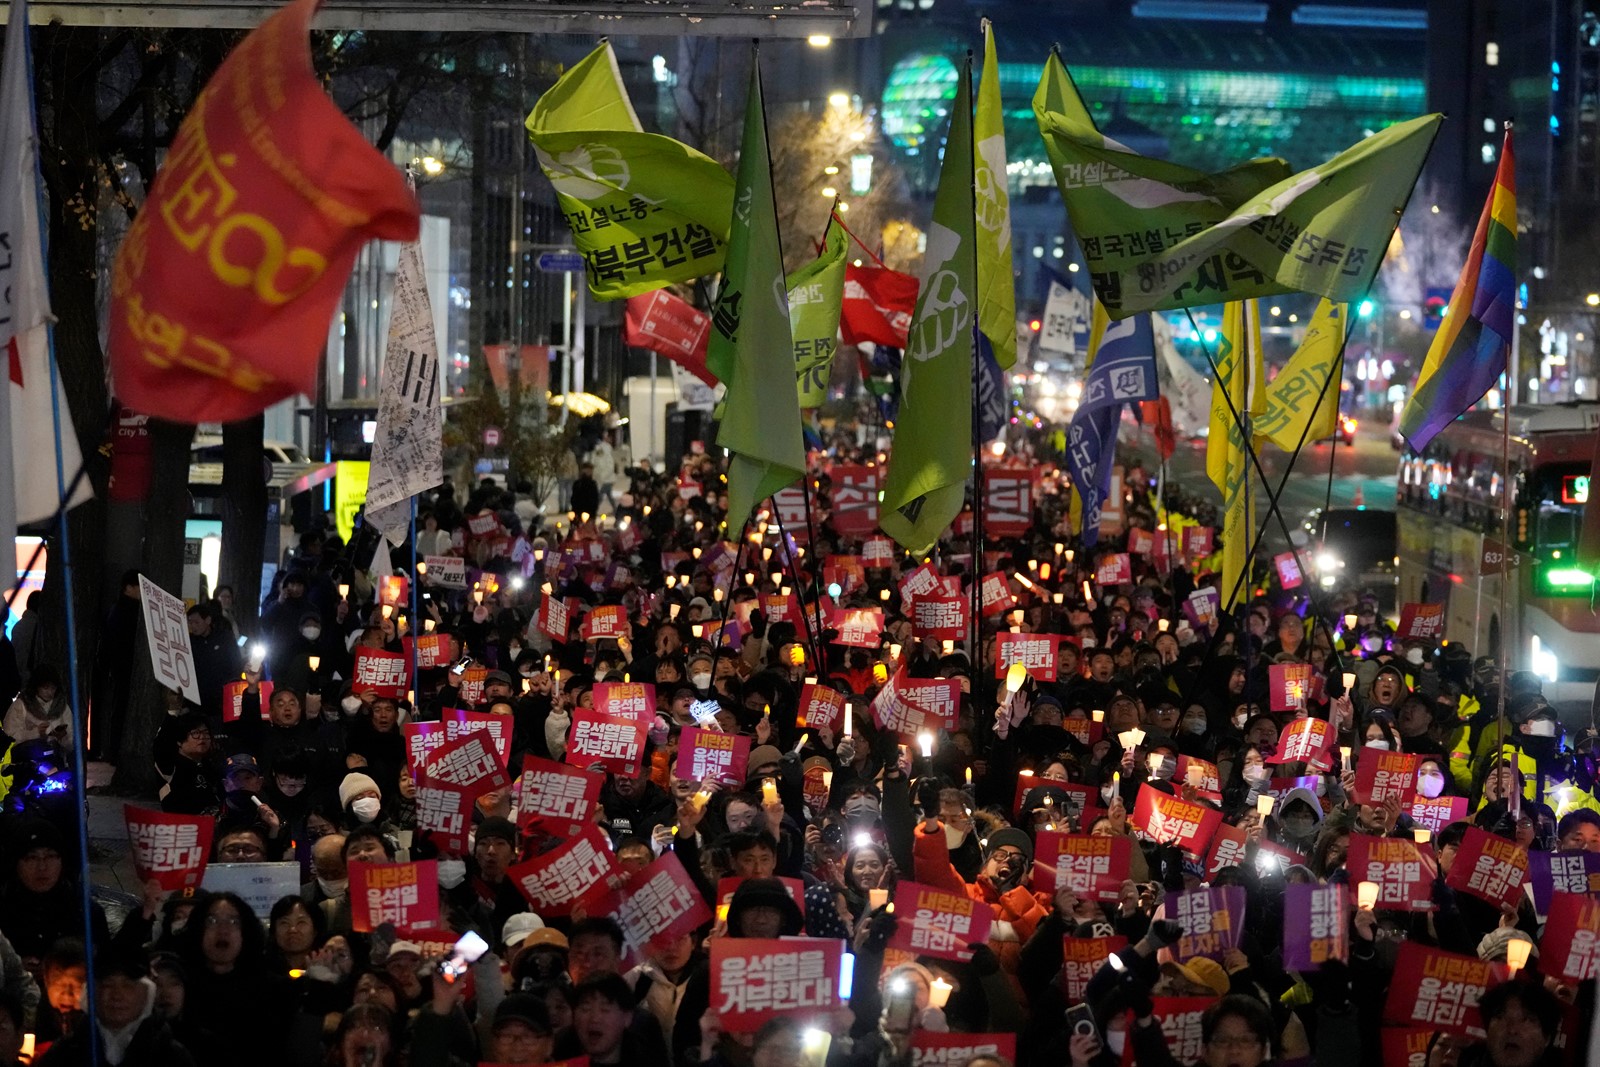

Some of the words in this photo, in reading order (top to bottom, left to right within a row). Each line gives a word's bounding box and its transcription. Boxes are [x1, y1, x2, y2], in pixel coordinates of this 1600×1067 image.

[563, 198, 663, 236] 건설노동
[119, 428, 136, 438] City
[592, 606, 617, 618] 내란죄
[915, 600, 962, 615] 국정농단
[592, 614, 618, 625] 윤석열
[592, 623, 613, 634] 퇴진!
[915, 613, 964, 629] 규명하라!
[1001, 640, 1051, 656] 윤석열을
[358, 656, 405, 673] 윤석열을
[1000, 653, 1054, 670] 거부한다!
[355, 669, 407, 687] 거부한다!
[608, 684, 646, 700] 내란죄
[812, 688, 844, 706] 내란죄
[608, 698, 646, 713] 윤석열
[808, 699, 839, 717] 윤석열
[806, 710, 832, 725] 퇴진!
[576, 720, 638, 744] 윤석열을
[695, 733, 735, 751] 내란죄
[572, 737, 639, 761] 거부한다!
[693, 747, 733, 766] 윤석열
[1377, 754, 1416, 772] 내란죄
[524, 770, 588, 794] 윤석열을
[1373, 770, 1414, 789] 윤석열
[416, 786, 462, 813] 석열을
[518, 790, 588, 822] 거부한다!
[1157, 795, 1206, 823] 내란죄
[1411, 803, 1452, 820] 윤석열
[1148, 809, 1200, 840] 윤석열
[1058, 837, 1112, 856] 내란죄
[1368, 842, 1420, 863] 내란죄
[1482, 838, 1530, 871] 내란죄
[521, 837, 598, 891] 윤석열을
[1055, 853, 1111, 875] 윤석열
[1366, 860, 1421, 883] 윤석열
[1474, 854, 1526, 890] 윤석열
[1550, 855, 1586, 876] 퇴진
[364, 866, 418, 887] 내란죄
[1055, 870, 1097, 892] 퇴진!
[1467, 871, 1510, 901] 퇴진!
[366, 884, 418, 908] 윤석열
[916, 890, 974, 917] 내란죄
[368, 906, 409, 931] 퇴진!
[912, 907, 972, 935] 윤석열
[911, 926, 956, 952] 퇴진!
[721, 949, 826, 984] 윤석열을
[1422, 953, 1492, 984] 내란죄
[719, 975, 833, 1014] 거부한다!
[1417, 976, 1487, 1008] 윤석열
[1410, 1000, 1468, 1027] 퇴진!
